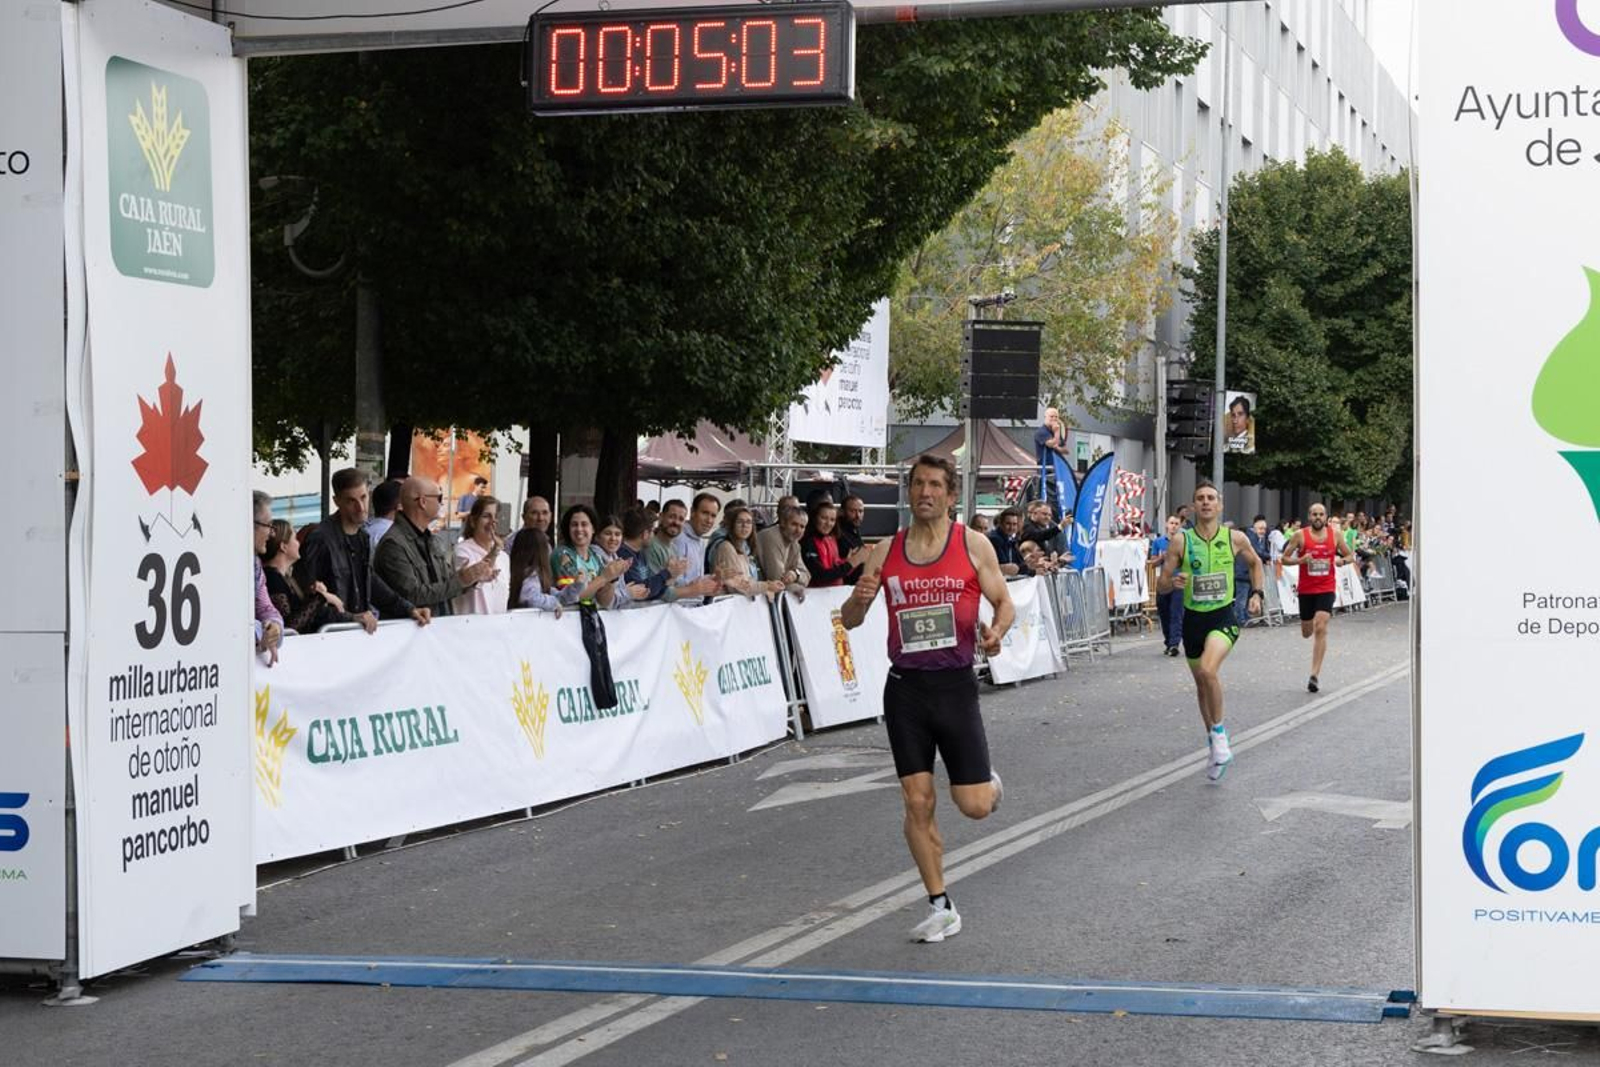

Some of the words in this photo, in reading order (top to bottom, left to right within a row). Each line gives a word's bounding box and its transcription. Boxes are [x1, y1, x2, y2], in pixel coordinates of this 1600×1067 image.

[1526, 127, 1582, 167] de
[119, 193, 157, 223] CAJA
[158, 200, 206, 234] RURAL
[146, 226, 182, 256] JAÉN
[134, 551, 201, 650] 36
[1523, 592, 1600, 609] Patrona
[915, 618, 936, 633] 63
[1518, 618, 1541, 634] de
[1548, 618, 1600, 638] Depo
[109, 664, 154, 702] milla
[157, 660, 219, 696] urbana
[110, 694, 218, 743] internacional
[556, 685, 595, 724] CAJA
[306, 716, 369, 765] CAJA
[367, 704, 460, 757] RURAL
[128, 744, 152, 780] de
[153, 737, 201, 774] otoño
[131, 773, 199, 820] manuel
[121, 814, 210, 873] pancorbo
[0, 868, 28, 880] MA
